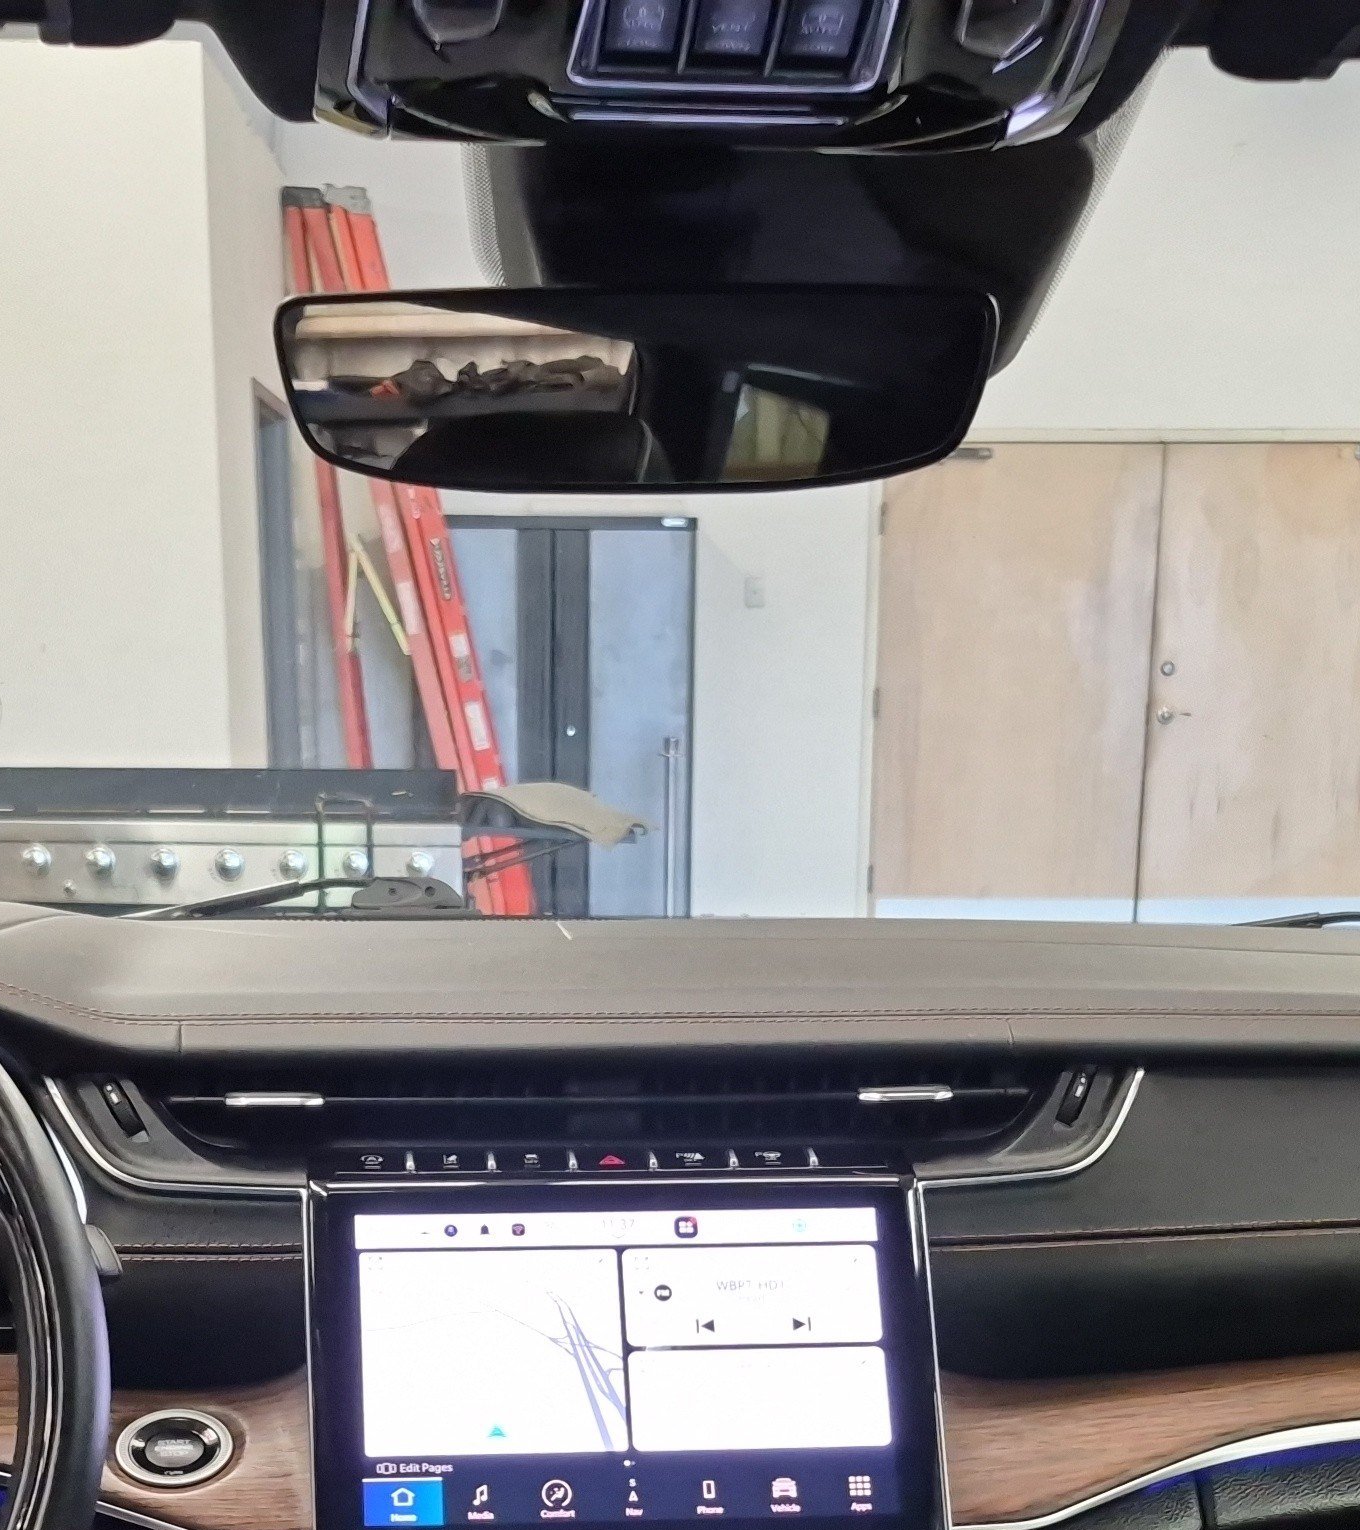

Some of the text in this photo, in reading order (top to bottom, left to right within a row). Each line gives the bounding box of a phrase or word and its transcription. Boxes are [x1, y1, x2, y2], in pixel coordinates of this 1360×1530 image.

[399, 1463, 453, 1475] Edit Pages
[696, 1505, 724, 1515] Phone
[770, 1502, 802, 1513] Vehicle
[850, 1501, 873, 1512] Apps
[467, 1510, 495, 1520] Media
[540, 1508, 576, 1519] Comfort
[625, 1507, 643, 1517] Nav
[390, 1513, 417, 1522] Home
